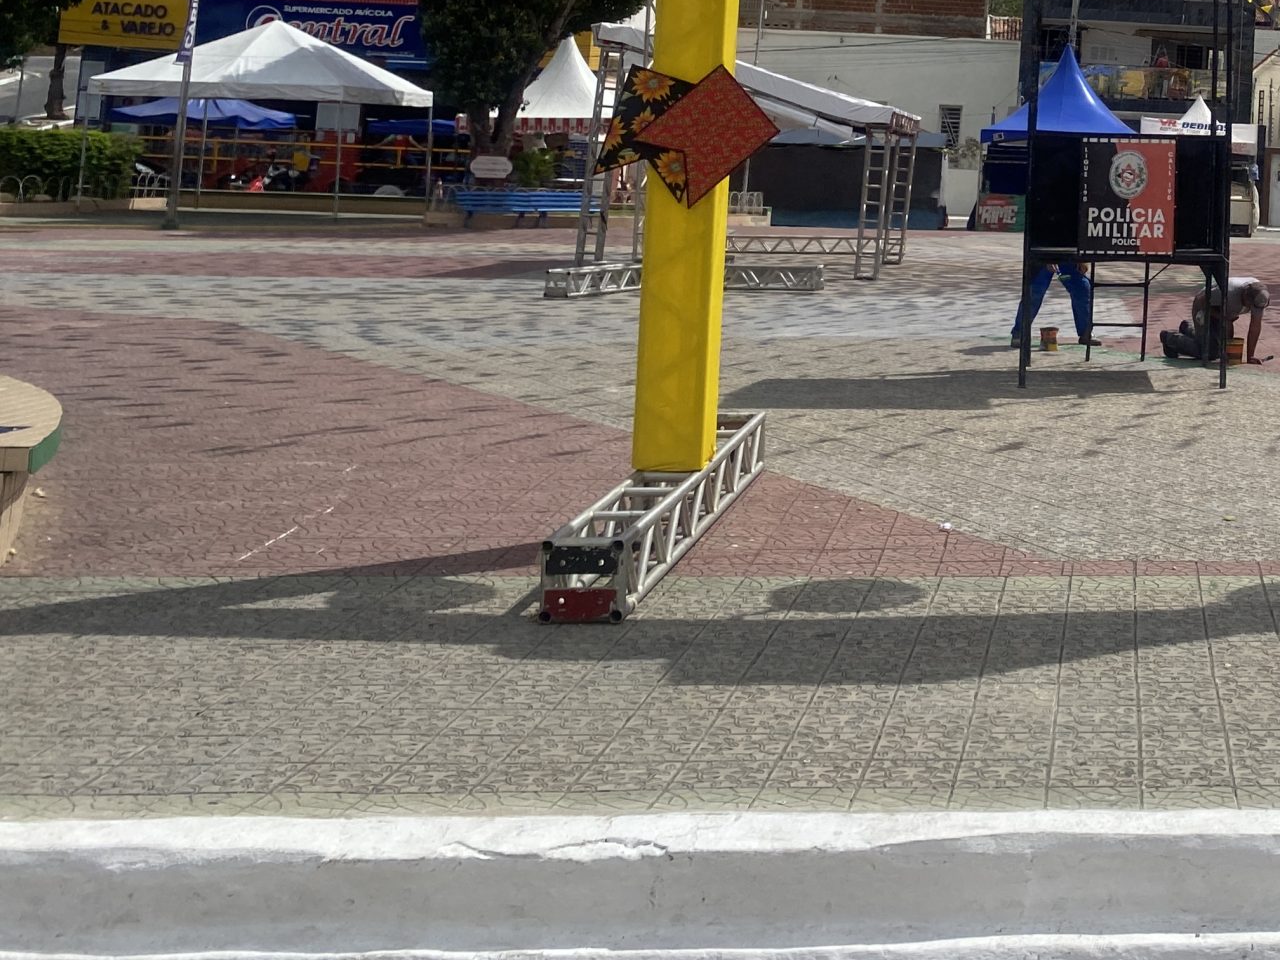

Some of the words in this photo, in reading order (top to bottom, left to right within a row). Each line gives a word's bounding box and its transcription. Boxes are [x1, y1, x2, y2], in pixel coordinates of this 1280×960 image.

[91, 2, 168, 20] ATACADO
[283, 5, 353, 16] SUPERMERCADO
[354, 7, 394, 17] AVÍCOLA
[120, 20, 176, 37] VAREJO
[1088, 203, 1166, 223] POLÍCIA
[1087, 223, 1164, 238] MILITAR
[1111, 238, 1141, 246] POLICE
